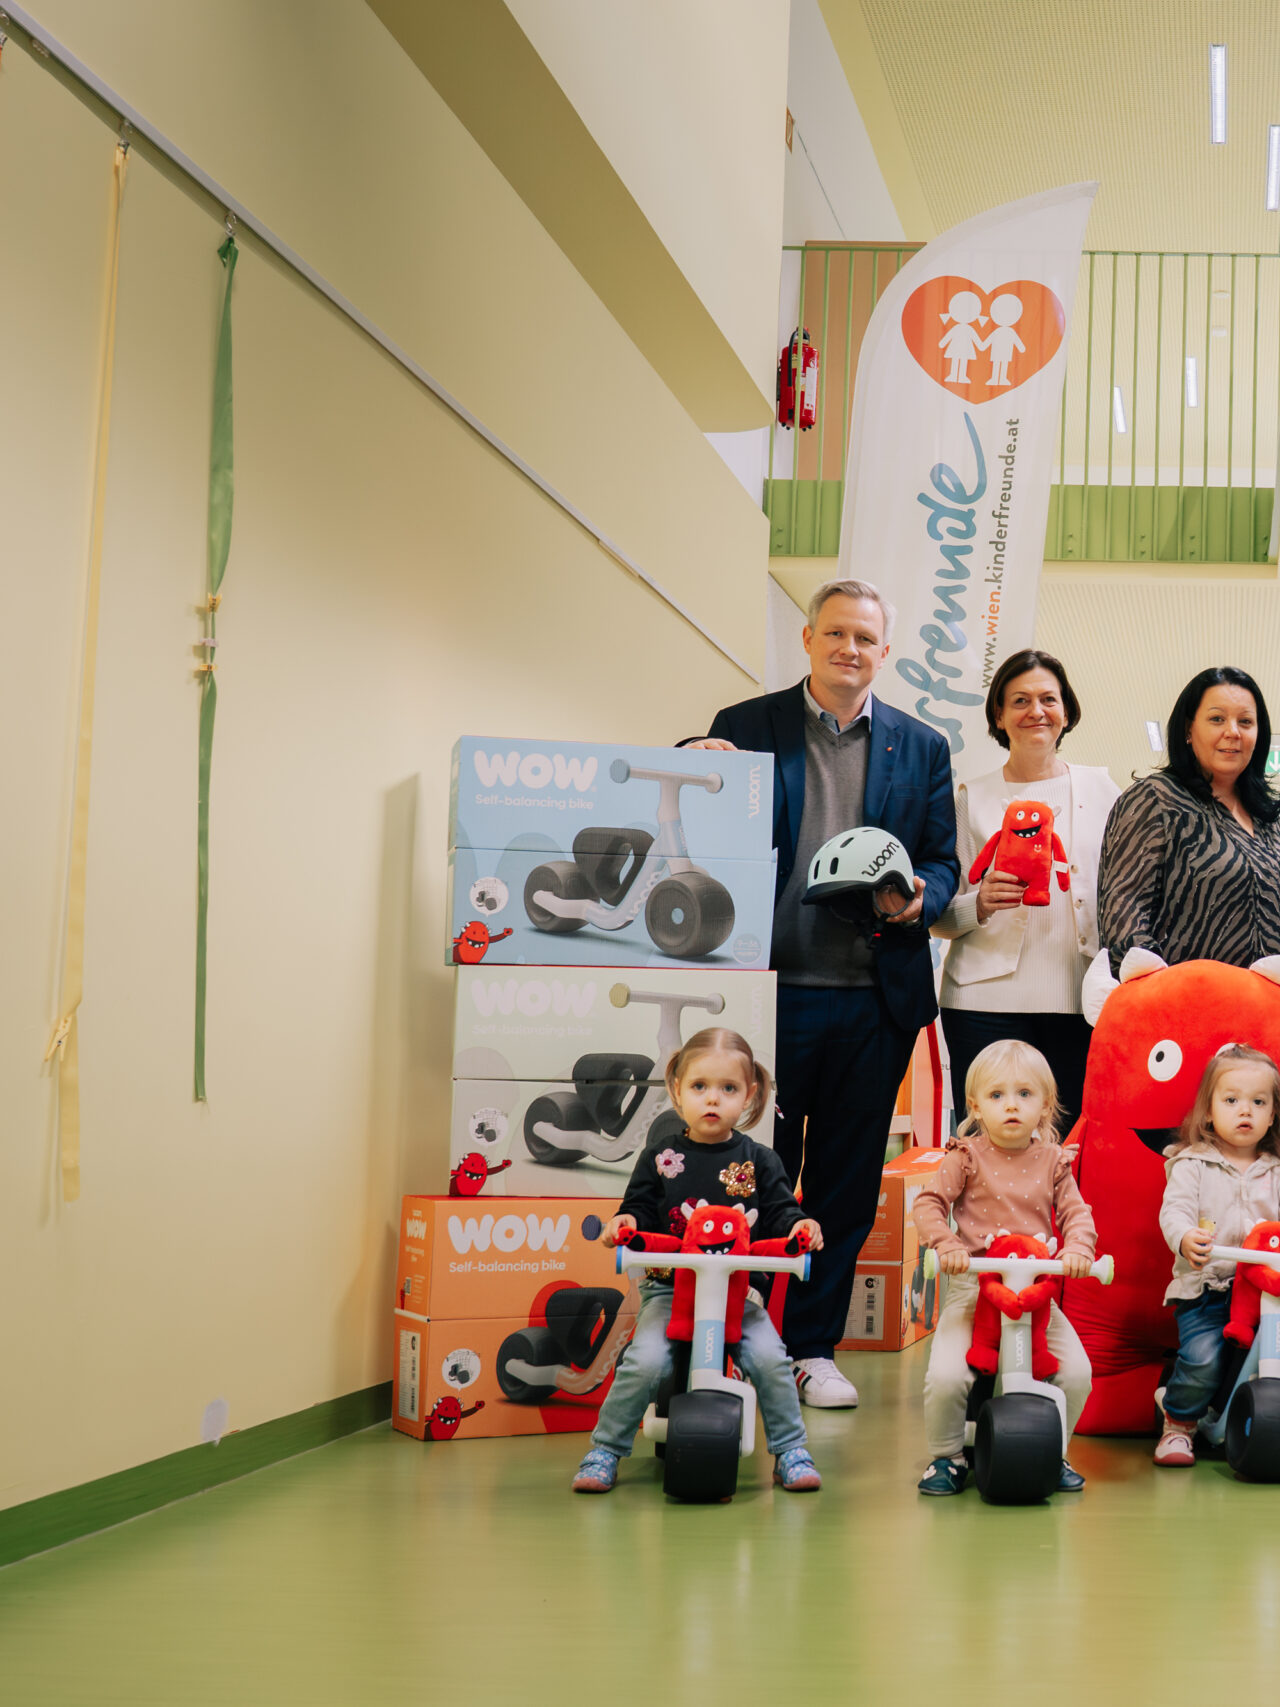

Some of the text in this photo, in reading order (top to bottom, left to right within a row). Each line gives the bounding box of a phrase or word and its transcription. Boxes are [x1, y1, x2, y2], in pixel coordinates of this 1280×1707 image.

[981, 418, 1020, 689] www.wien.kinderfreunde.at
[895, 411, 986, 756] rfreunde
[474, 750, 598, 792] WOW
[748, 764, 761, 819] woom
[475, 794, 594, 810] Self-balancing bike
[861, 841, 900, 877] woom
[472, 979, 598, 1018] WOW
[448, 1213, 571, 1255] WOW
[449, 1259, 567, 1273] Self-balancing bike
[1015, 1329, 1025, 1369] woom
